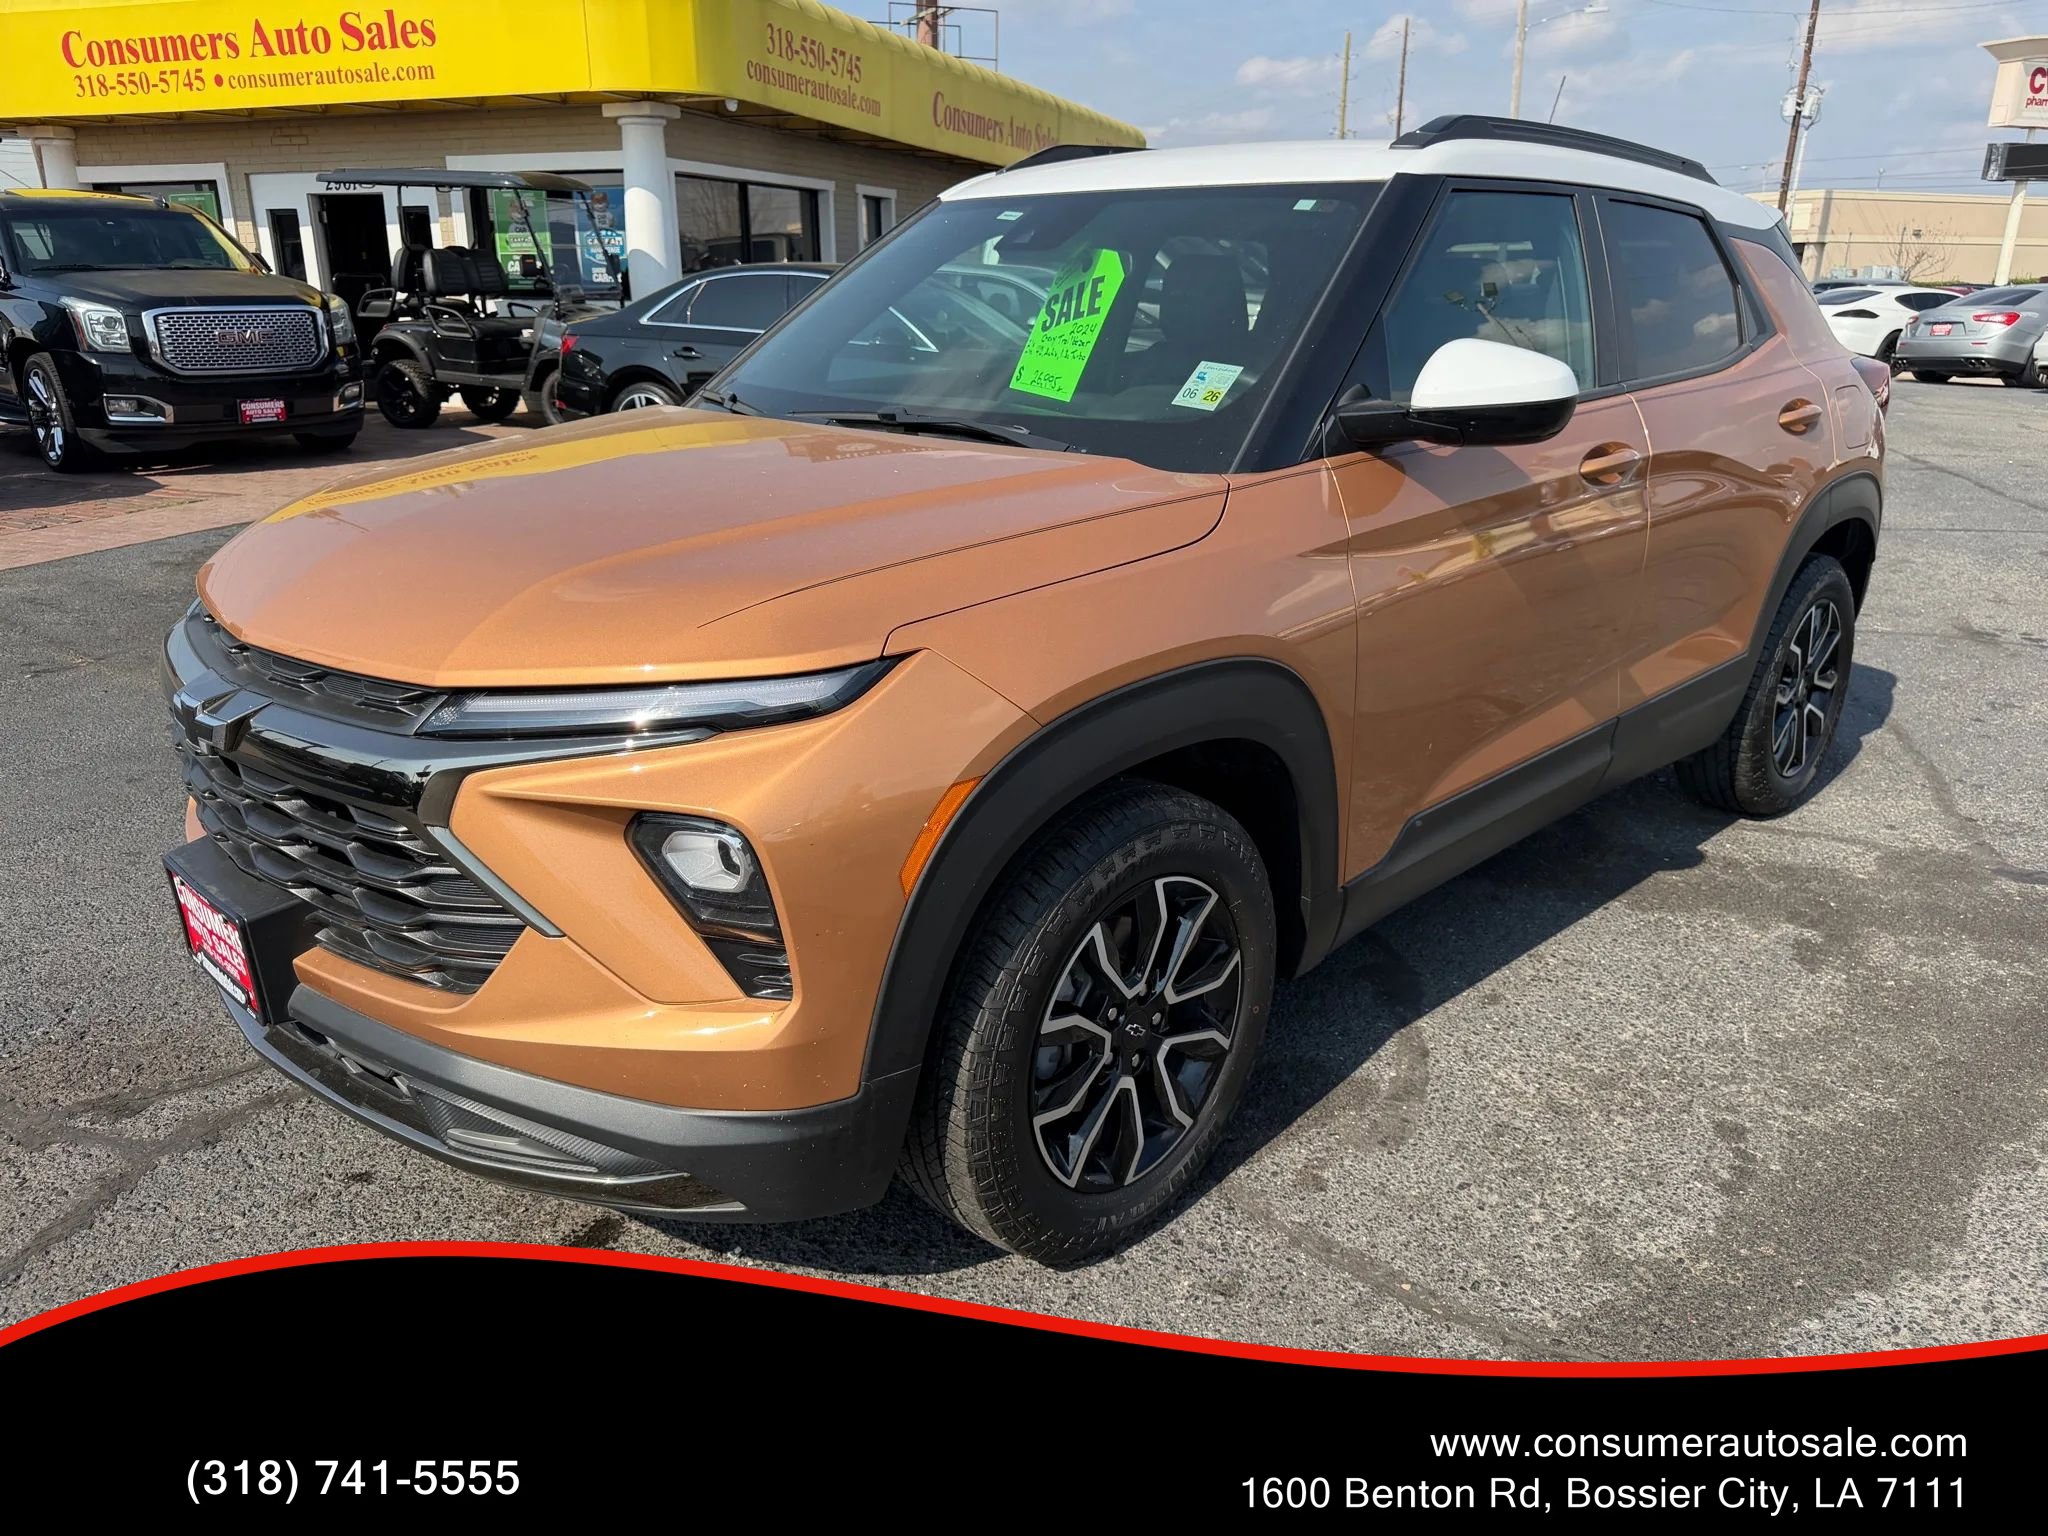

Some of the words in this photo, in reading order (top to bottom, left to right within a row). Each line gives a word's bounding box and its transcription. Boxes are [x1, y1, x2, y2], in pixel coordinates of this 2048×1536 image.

[61, 30, 240, 69] Consumers
[250, 18, 332, 58] Auto
[339, 9, 437, 52] Sales
[766, 22, 862, 84] 318-550-5745
[74, 68, 206, 98] 318-550-5745
[228, 62, 436, 90] consumerautosale.com
[746, 59, 881, 118] consumerautosale.com
[933, 91, 1004, 145] Consumers
[1006, 115, 1032, 152] Auto
[1040, 274, 1106, 333] SALE
[1069, 322, 1097, 335] 2024
[217, 329, 273, 346] GMC
[241, 401, 285, 410] CONSUMERS
[1182, 387, 1199, 399] 06
[1203, 390, 1221, 402] 26
[173, 875, 246, 960] CONSUMERS
[187, 910, 213, 947] AUTO
[211, 934, 247, 976] SALES
